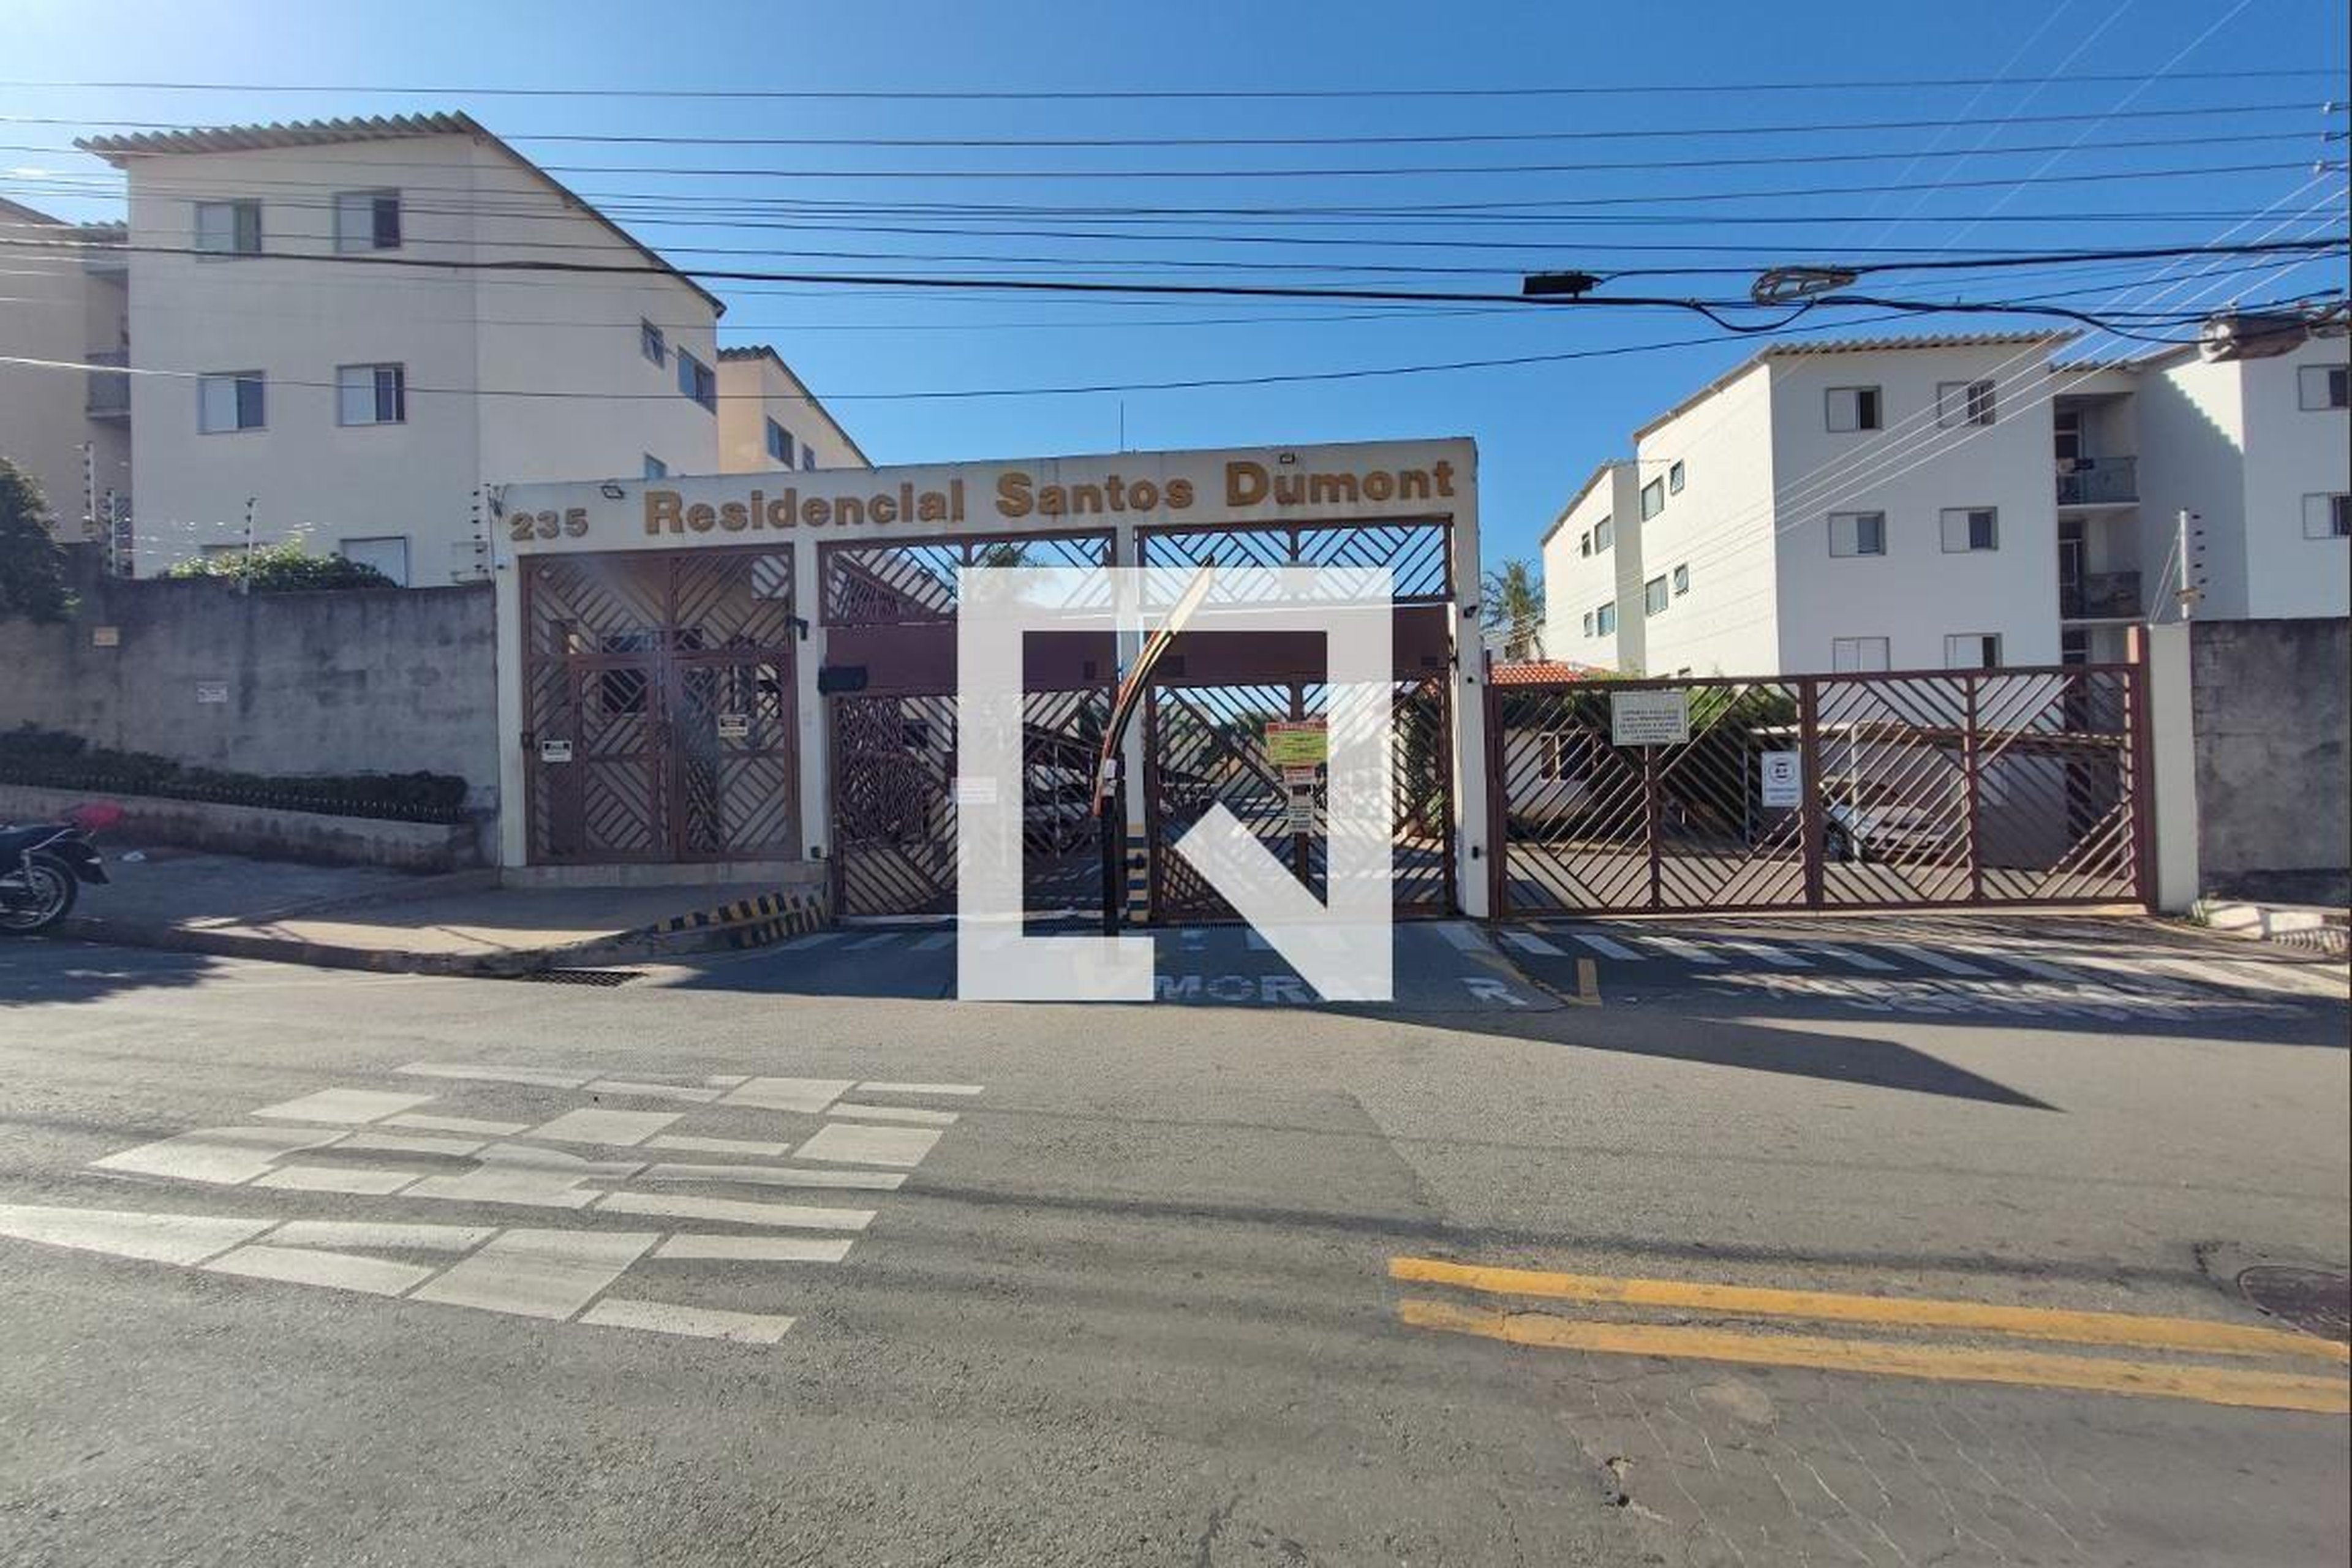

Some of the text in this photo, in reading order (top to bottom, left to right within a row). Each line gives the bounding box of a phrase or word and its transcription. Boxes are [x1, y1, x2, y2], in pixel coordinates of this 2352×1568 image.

[510, 508, 589, 541] 235
[646, 460, 1455, 535] Residencial Santos Dumont
